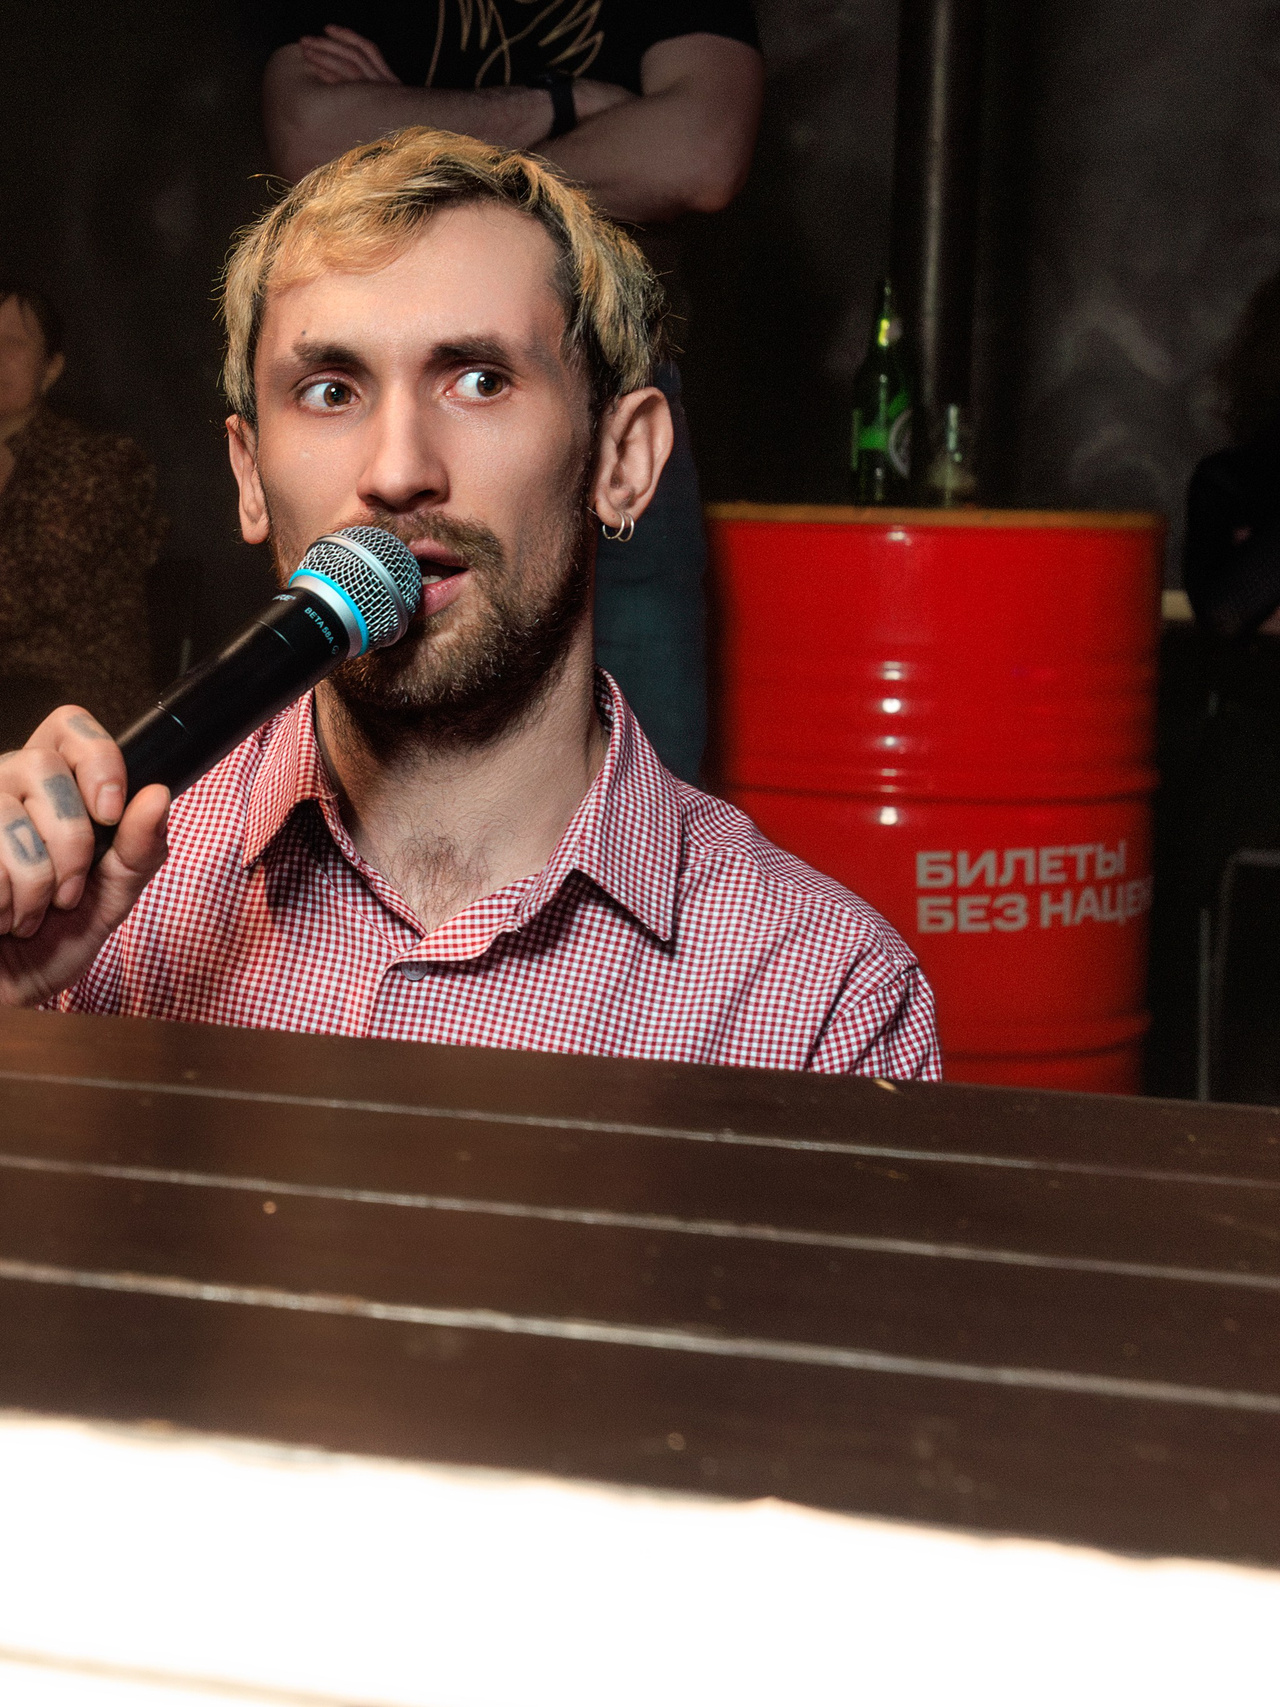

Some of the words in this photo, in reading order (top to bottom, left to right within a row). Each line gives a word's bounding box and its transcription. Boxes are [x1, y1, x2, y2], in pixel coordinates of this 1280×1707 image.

[304, 606, 325, 629] BETA
[915, 841, 1127, 889] БИЛЕТЫ
[916, 893, 1029, 935] БЕЗ
